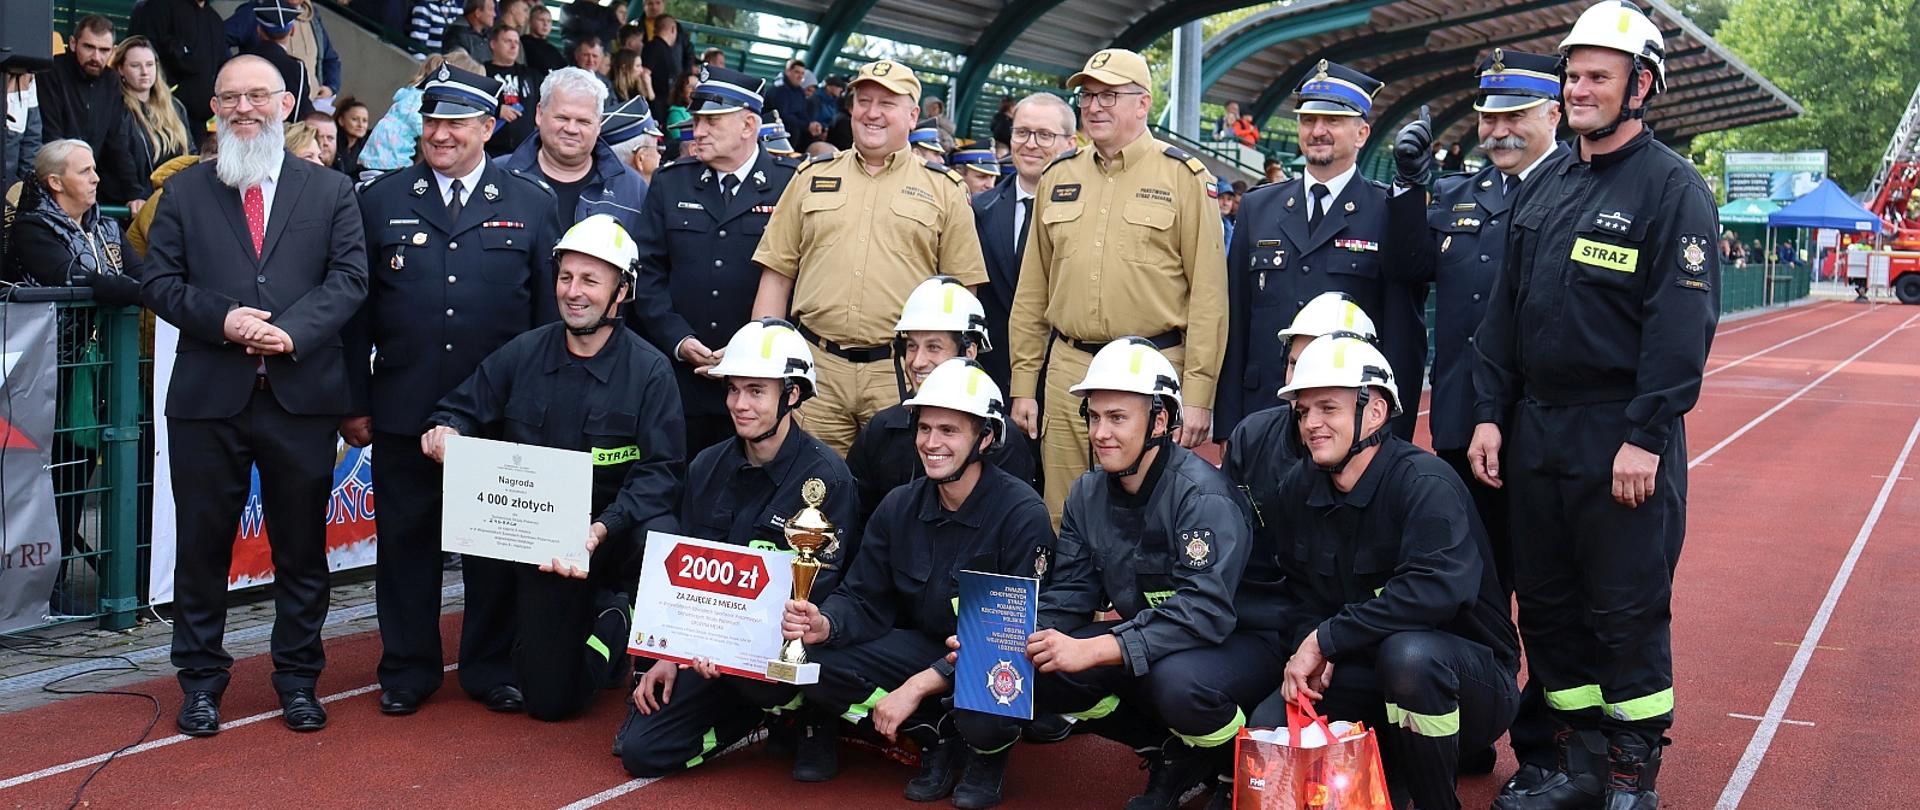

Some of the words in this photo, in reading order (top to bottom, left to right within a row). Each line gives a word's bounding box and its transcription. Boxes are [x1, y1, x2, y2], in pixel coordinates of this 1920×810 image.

[498, 475, 535, 488] Nagroda
[476, 491, 485, 503] 4
[487, 492, 509, 506] 000
[511, 497, 554, 513] złotych
[19, 541, 53, 568] RP
[678, 554, 734, 585] 2000
[738, 565, 759, 589] zł
[718, 599, 747, 611] MIEJSCA
